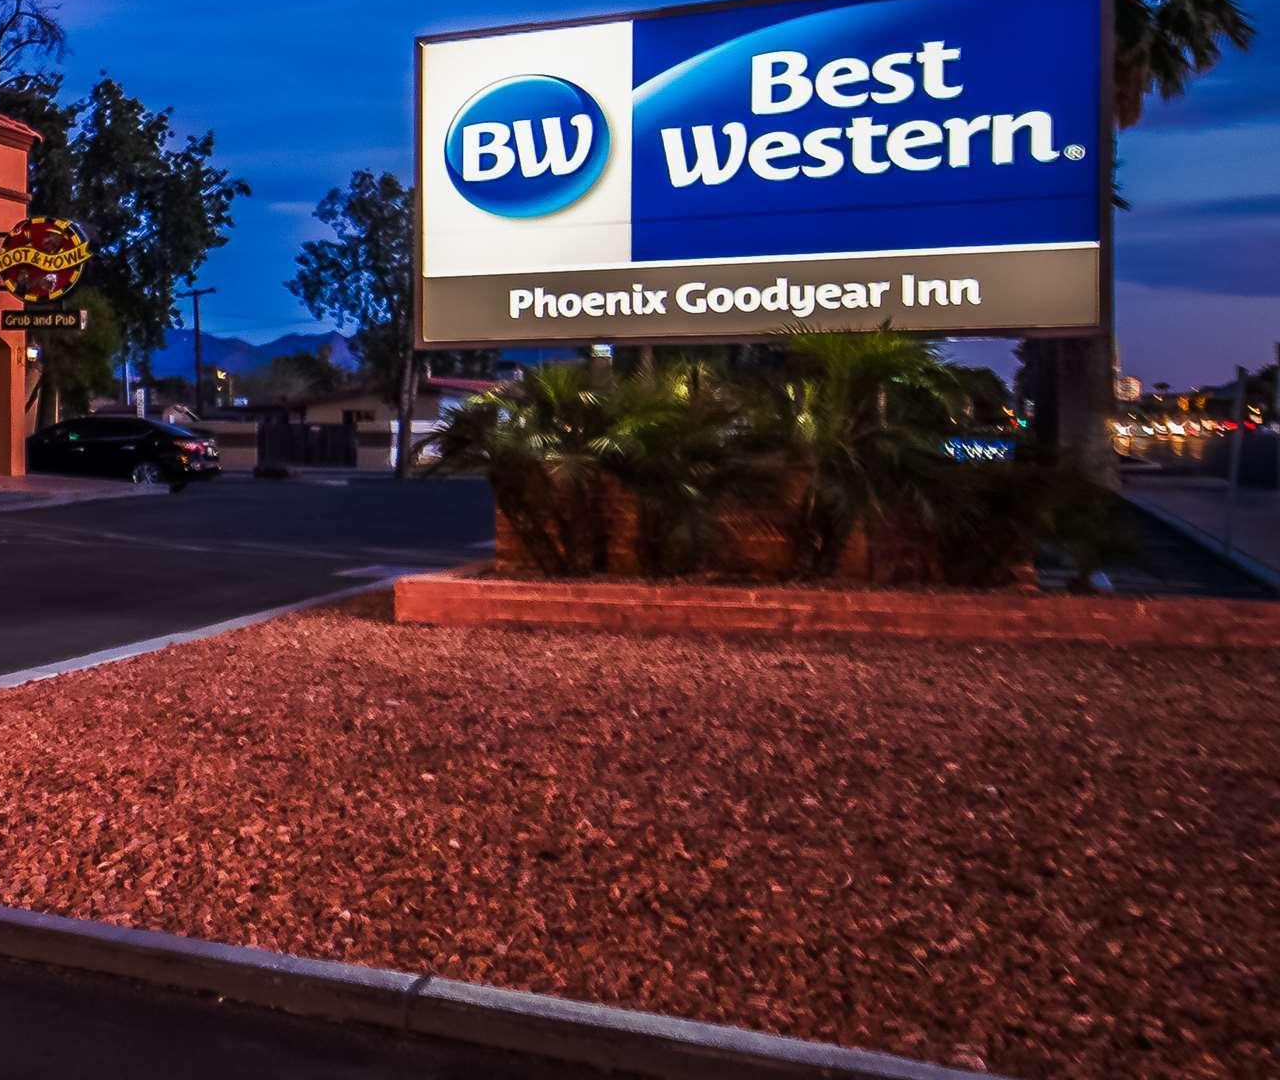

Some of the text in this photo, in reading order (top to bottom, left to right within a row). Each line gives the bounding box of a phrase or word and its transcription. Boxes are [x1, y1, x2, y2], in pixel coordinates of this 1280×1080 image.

[751, 40, 964, 115] Best
[462, 113, 594, 182] BW
[30, 252, 40, 265] &
[43, 250, 85, 269] HOWL
[509, 274, 982, 319] Phoenix Goodyear Inn
[5, 314, 76, 326] Grub and Pub
